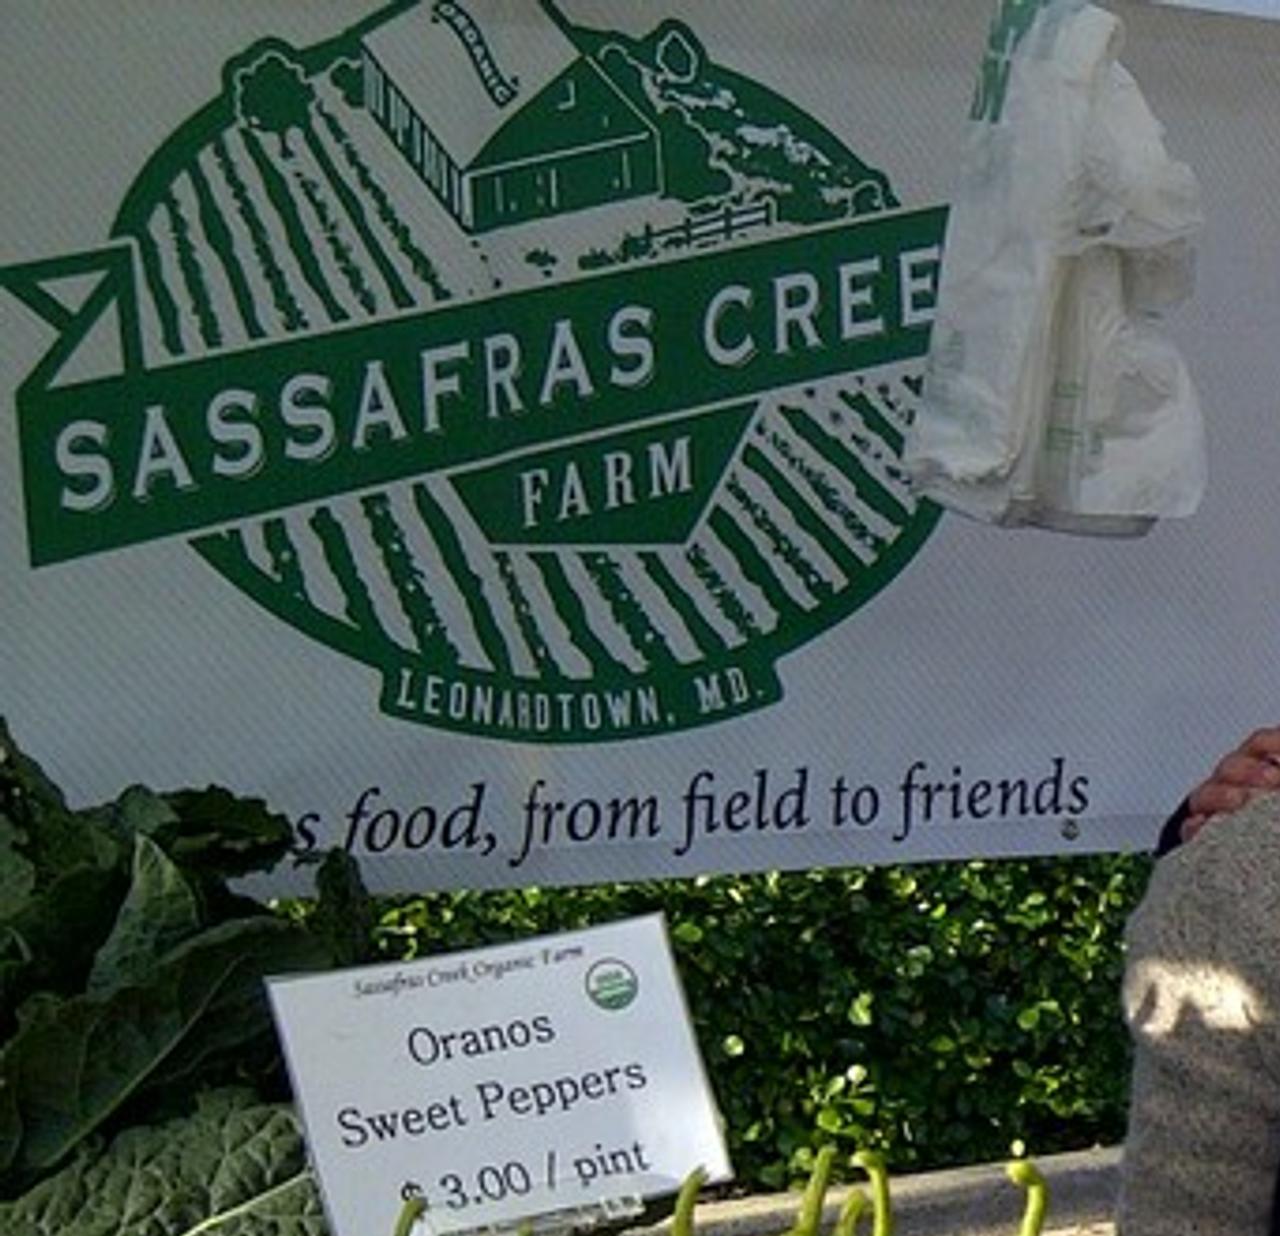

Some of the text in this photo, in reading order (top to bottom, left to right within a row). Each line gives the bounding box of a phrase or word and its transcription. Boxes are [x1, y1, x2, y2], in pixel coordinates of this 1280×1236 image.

[439, 2, 513, 102] ORGANIC
[55, 244, 940, 514] SASSAFRAS CREE
[516, 436, 696, 530] FARM
[396, 664, 765, 733] LEONARDTOWN, MD.
[343, 782, 498, 857] food,
[509, 778, 661, 867] from
[674, 768, 811, 856] field
[830, 778, 881, 827] to
[892, 756, 1091, 841] friends
[407, 1013, 557, 1066] Oranos
[336, 1060, 648, 1149] Sweet Peppers
[439, 1161, 531, 1211] 3.00
[545, 1150, 557, 1190] /
[573, 1138, 651, 1187] pint
